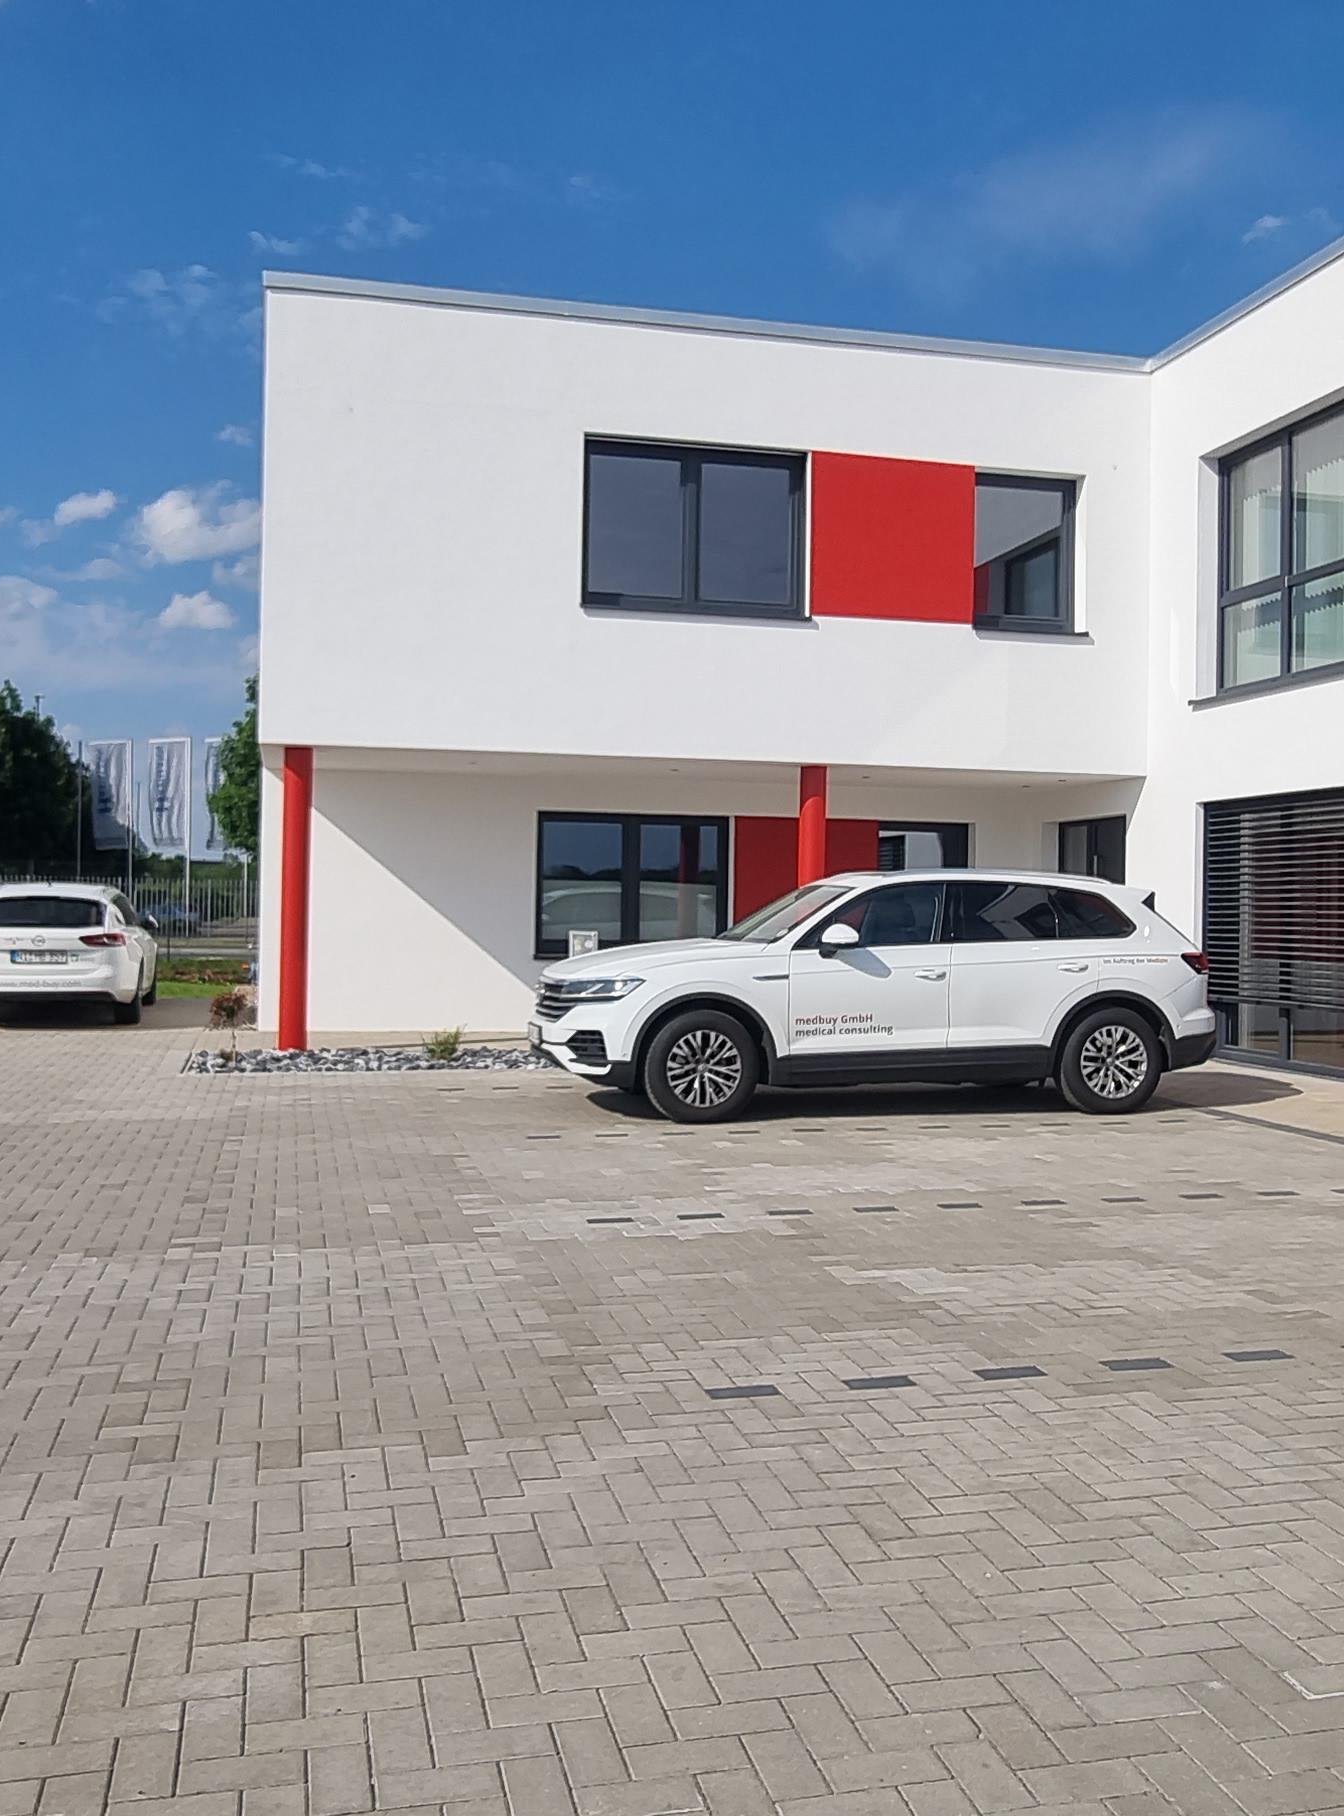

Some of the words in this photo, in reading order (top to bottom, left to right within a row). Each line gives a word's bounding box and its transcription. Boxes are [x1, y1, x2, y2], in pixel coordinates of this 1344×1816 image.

[795, 1015, 838, 1027] medbuy
[840, 1013, 874, 1025] GmbH
[795, 1026, 837, 1037] medical
[838, 1024, 894, 1036] consulting
